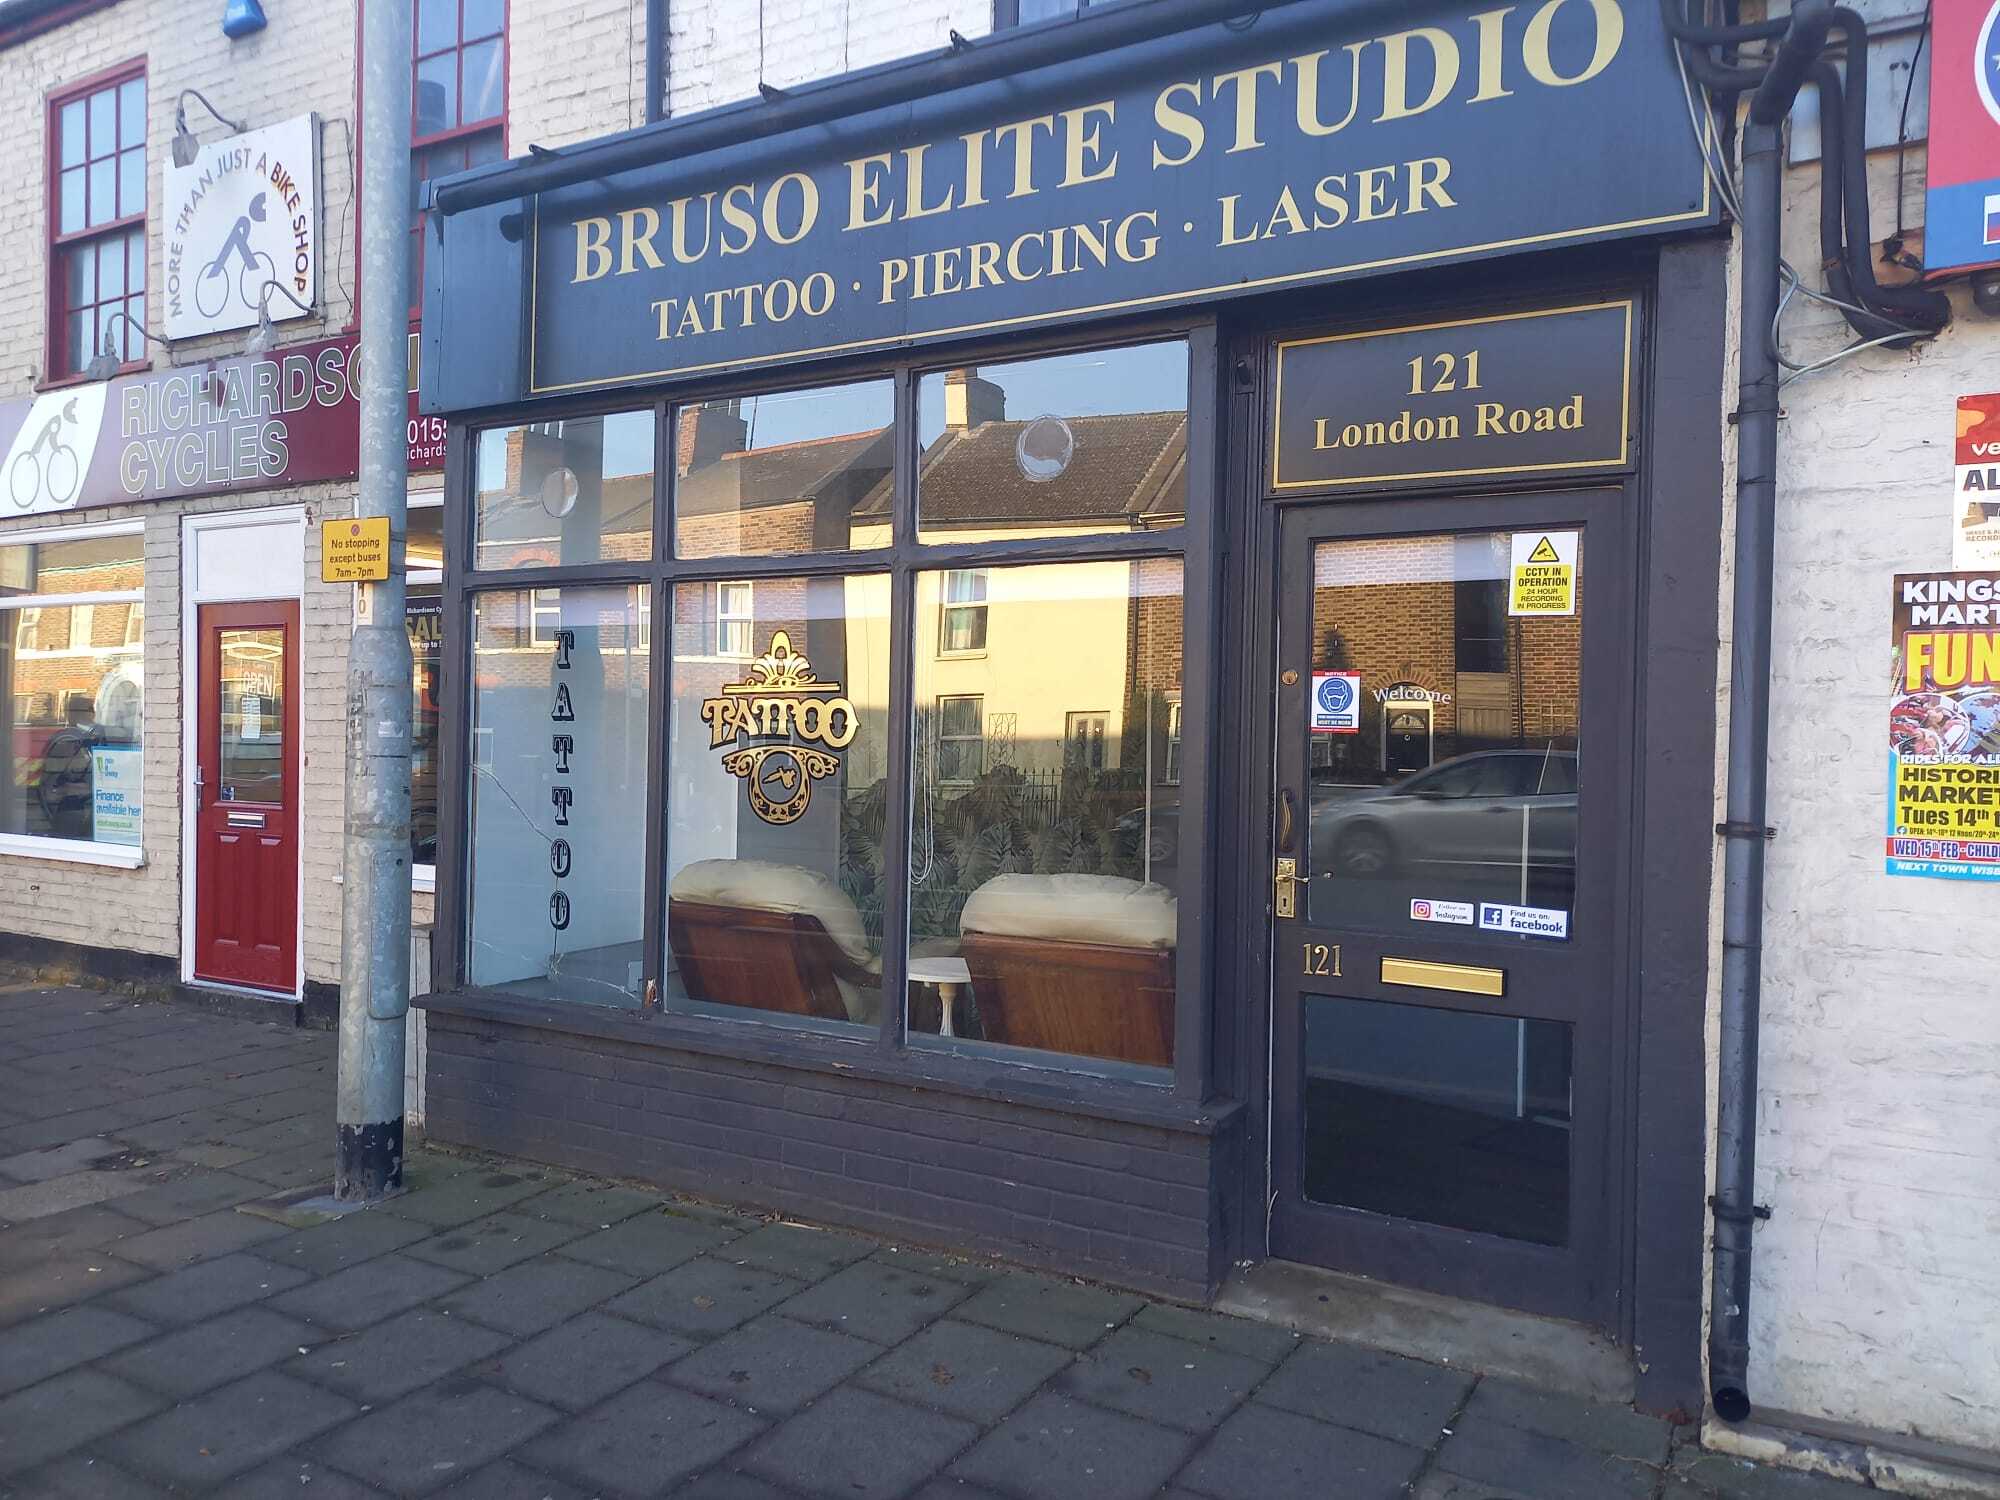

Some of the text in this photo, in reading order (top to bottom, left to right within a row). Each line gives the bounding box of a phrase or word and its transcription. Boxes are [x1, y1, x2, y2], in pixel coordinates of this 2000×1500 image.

[570, 0, 1624, 284] BRUSO ELITE STUDIO
[168, 148, 308, 317] MORE THAN JUST A BIKE SHOP
[651, 156, 1458, 341] TATTOO PIERCING LASER
[1405, 350, 1483, 395] 121
[121, 333, 420, 437] RICHARDS
[1312, 395, 1585, 451] London Road
[120, 420, 289, 494] CYCLES
[331, 538, 380, 550] No stopping
[329, 553, 381, 564] except buses
[1525, 567, 1561, 576] CCTV IN
[1518, 578, 1567, 587] OPERATION
[1906, 632, 2000, 690] FUN
[1371, 685, 1452, 704] Welcome
[700, 697, 861, 750] TATTOO
[550, 630, 575, 930] TATTOO
[1903, 767, 1999, 784] HISTORI
[96, 789, 124, 801] Finance
[96, 803, 127, 815] available
[1901, 806, 1950, 825] Tues
[1954, 808, 1989, 827] 14th
[1895, 840, 2000, 857] WED 15th FEB CHILD
[1896, 862, 1929, 871] NEXT
[1932, 863, 1968, 874] TOWN
[1510, 909, 1526, 918] Find
[1510, 917, 1563, 933] facebook
[1303, 943, 1343, 977] 121
